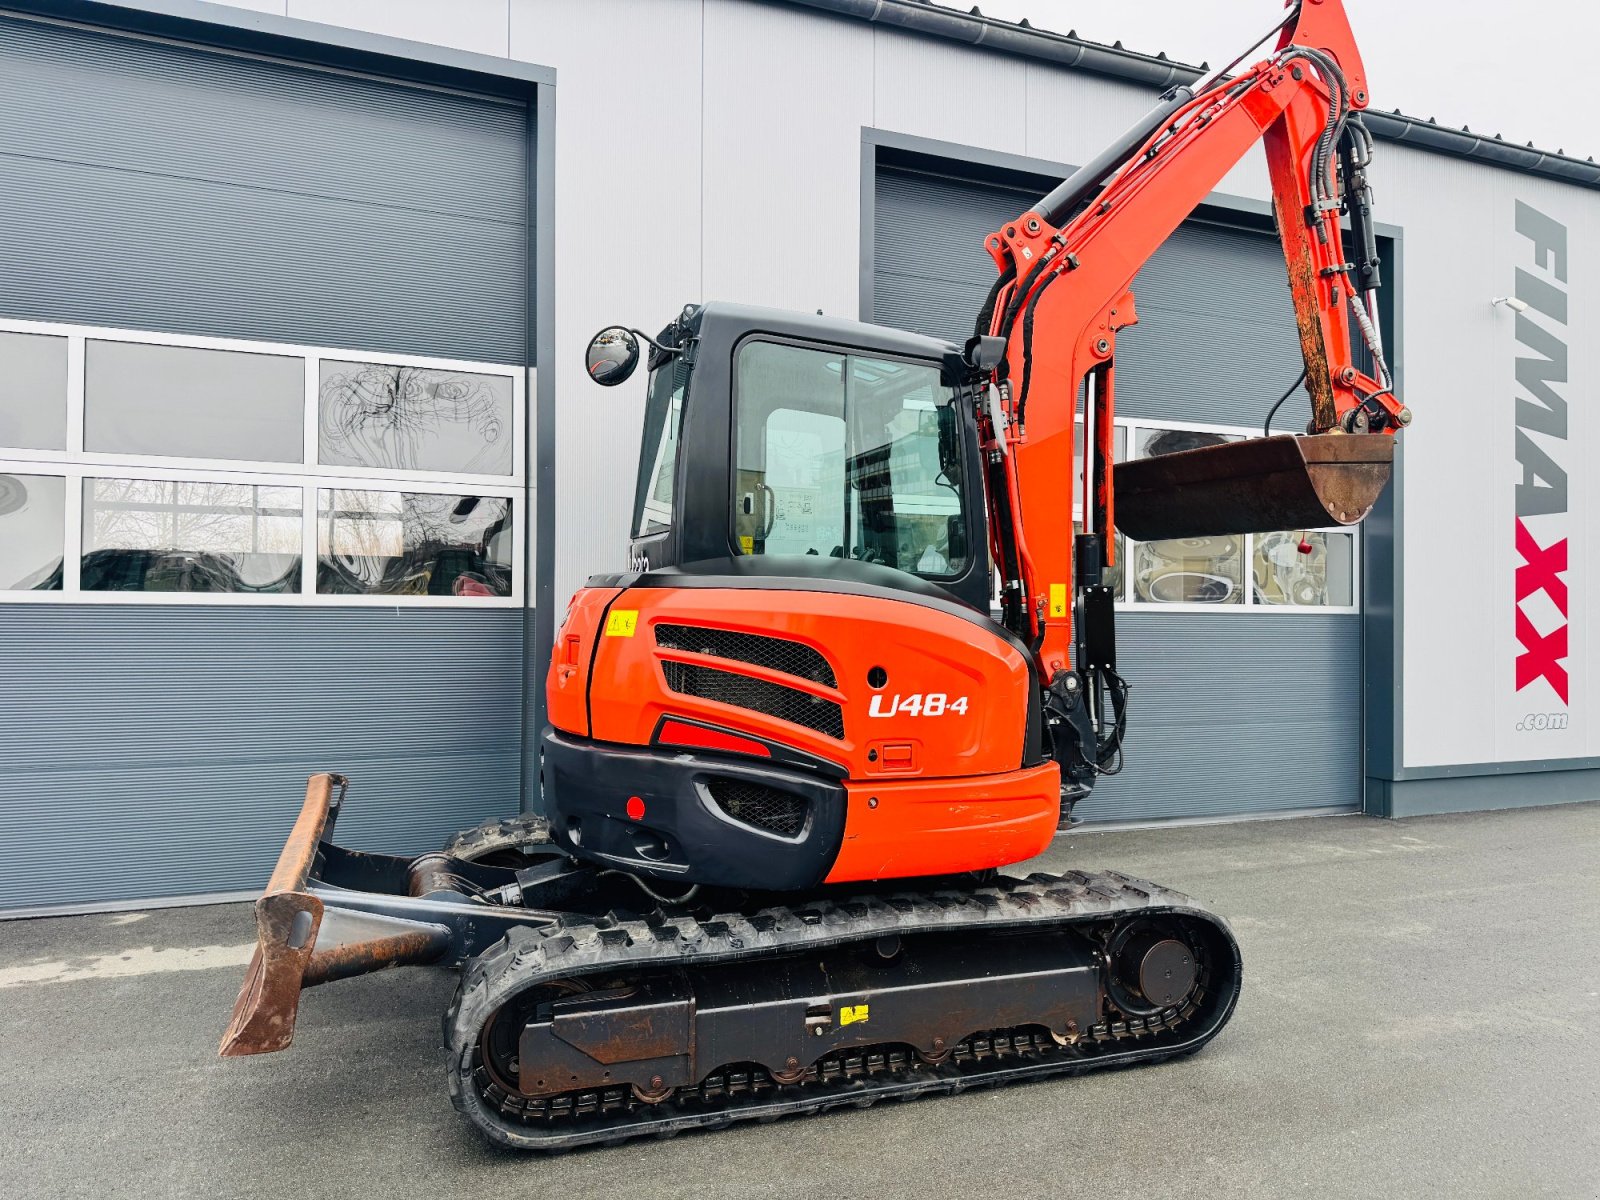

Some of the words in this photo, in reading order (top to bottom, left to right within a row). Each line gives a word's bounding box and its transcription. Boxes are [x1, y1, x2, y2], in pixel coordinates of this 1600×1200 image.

[1515, 198, 1568, 707] FIMAXX
[868, 693, 969, 718] U48-4
[1515, 713, 1568, 731] .com
